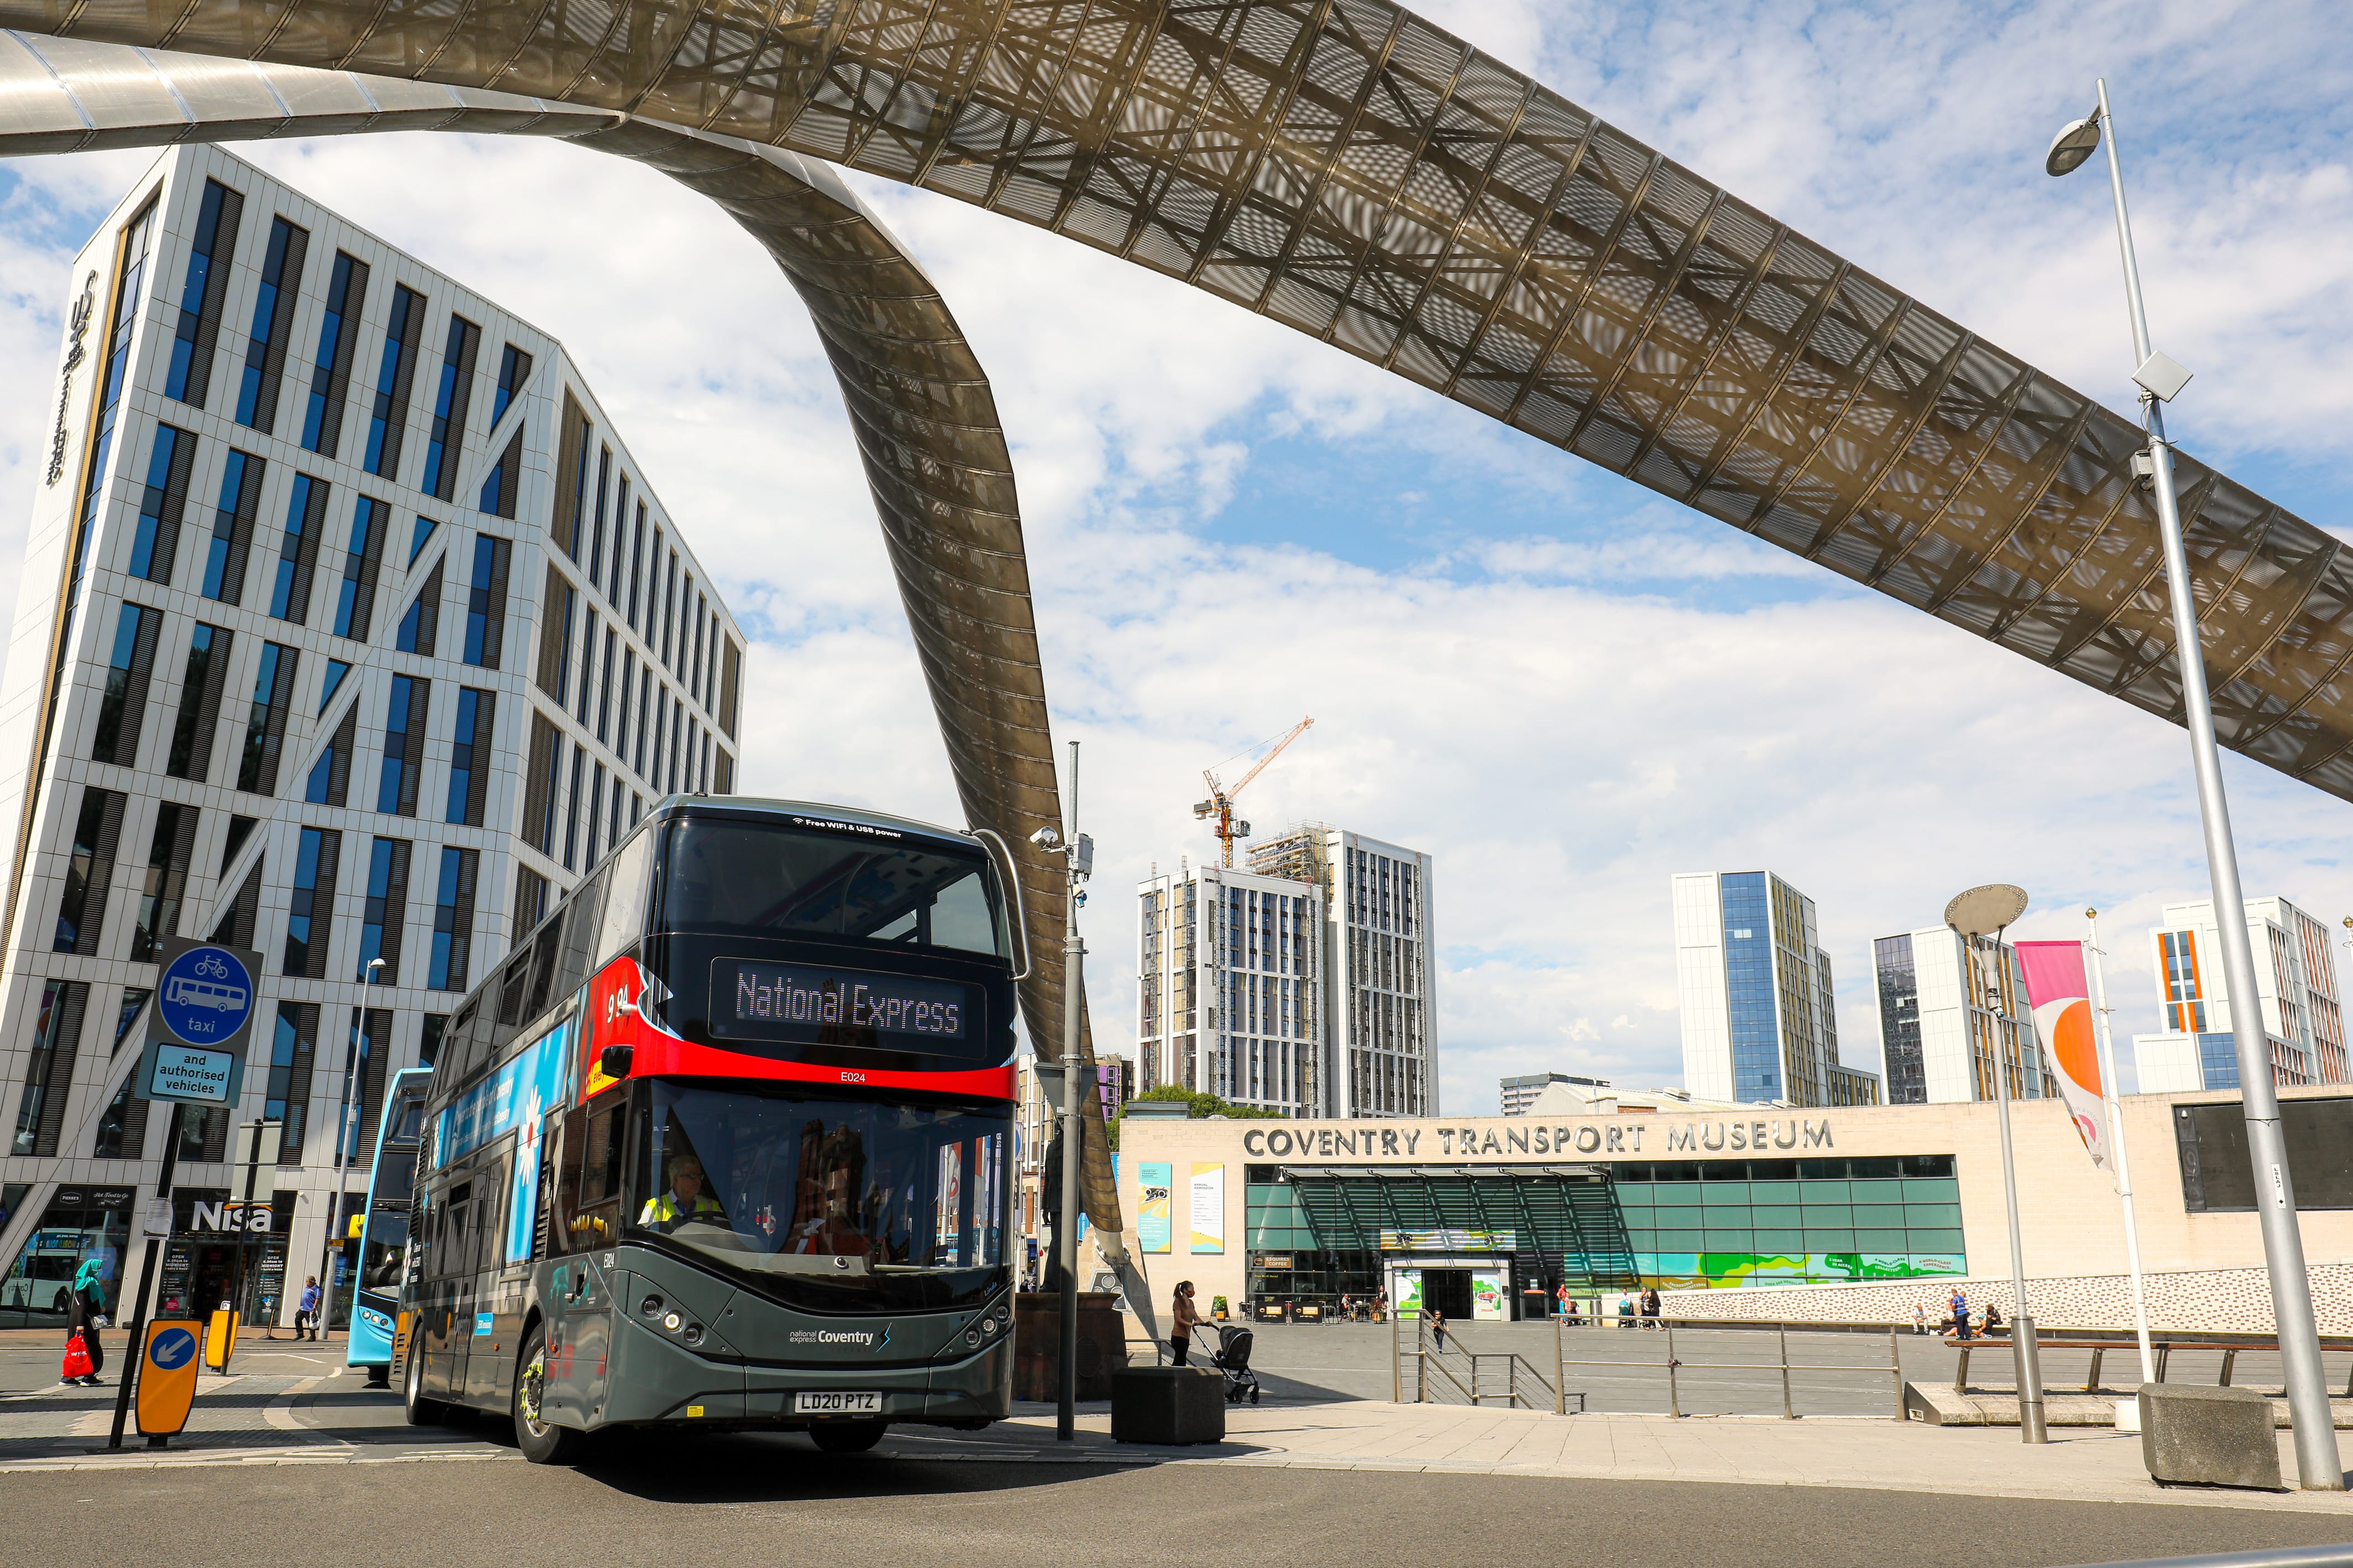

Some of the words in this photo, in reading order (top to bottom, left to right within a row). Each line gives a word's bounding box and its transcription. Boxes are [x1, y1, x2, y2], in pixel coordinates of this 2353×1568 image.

[875, 829, 901, 838] power
[607, 994, 614, 1023] 9
[736, 973, 845, 1024] National
[851, 984, 960, 1034] Express
[188, 1017, 215, 1032] taxi
[184, 1056, 206, 1065] and
[160, 1066, 225, 1081] authorised
[841, 1072, 865, 1083] E024
[166, 1080, 215, 1093] vehicles
[1244, 1129, 1421, 1156] COVENTRY
[1438, 1125, 1645, 1155] TRANSPORT
[1667, 1119, 1833, 1151] MUSEUM
[191, 1201, 272, 1232] Nisa
[604, 1253, 615, 1268] E024
[1878, 1258, 1905, 1266] WORLD-CLASS
[818, 1330, 873, 1346] Coventry
[801, 1394, 841, 1409] LD20
[845, 1394, 874, 1409] PTZ
